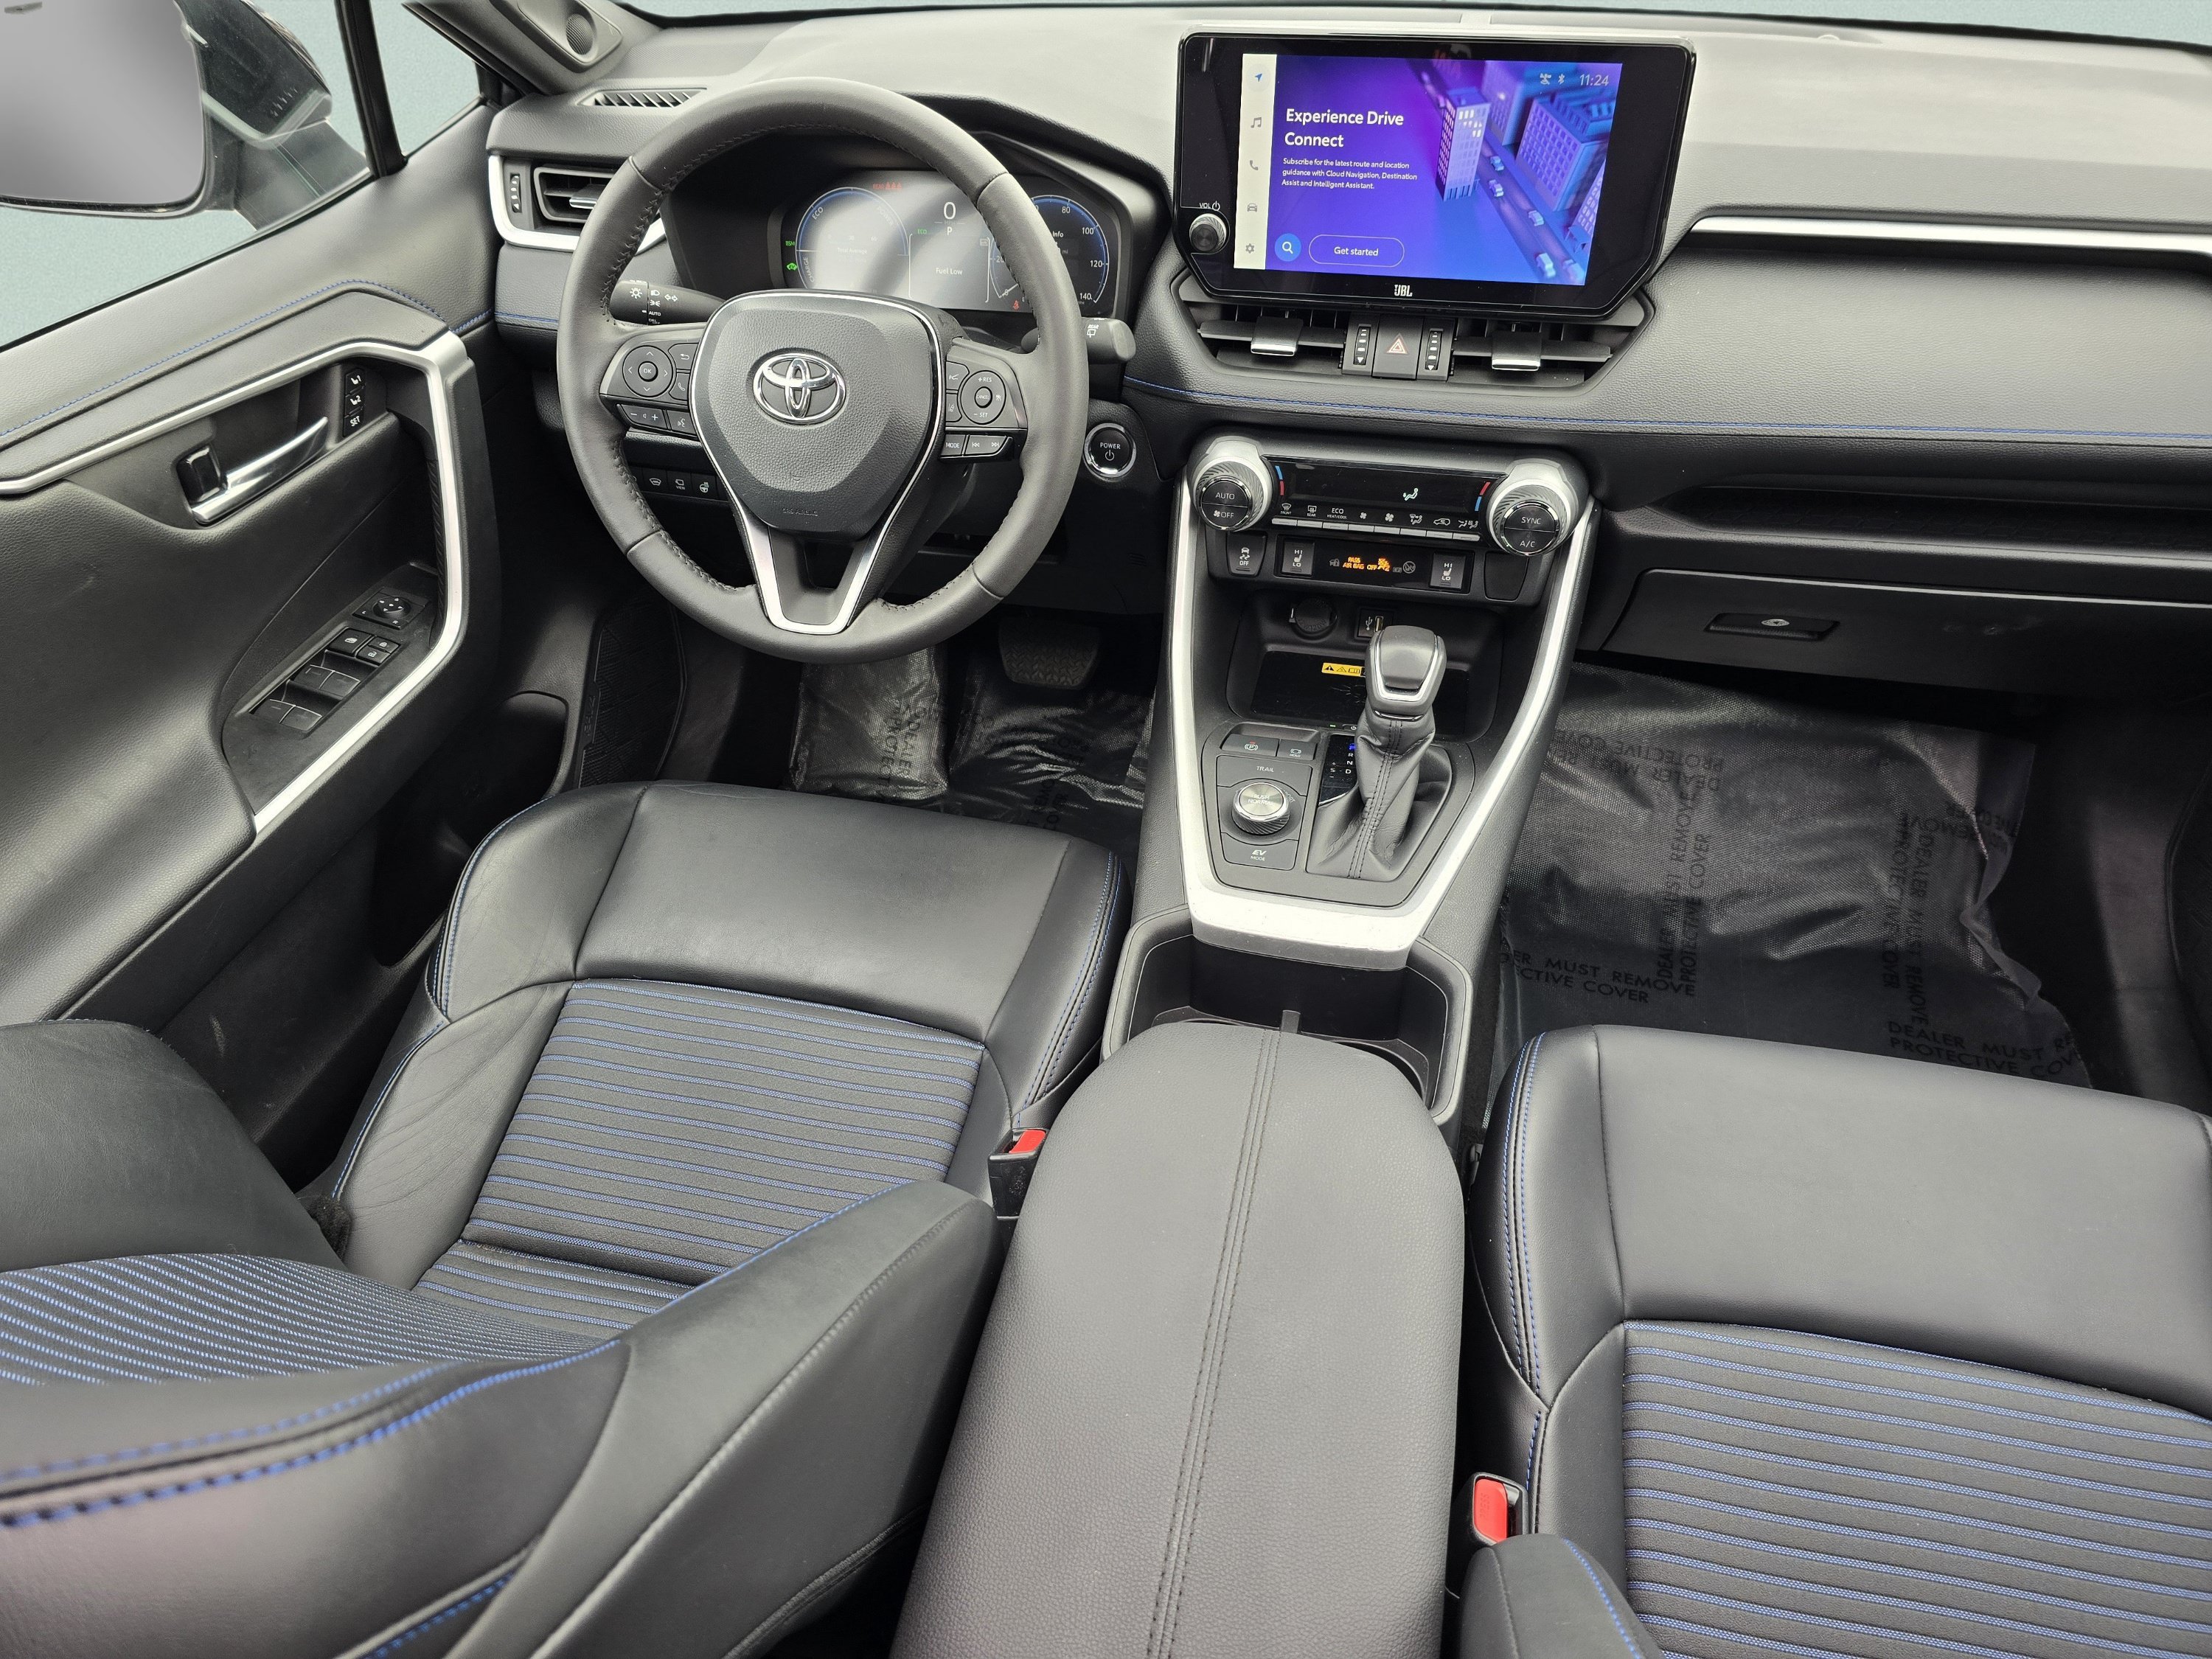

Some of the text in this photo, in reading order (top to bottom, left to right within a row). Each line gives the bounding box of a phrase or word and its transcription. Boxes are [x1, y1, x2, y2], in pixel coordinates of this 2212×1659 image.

[1579, 74, 1610, 86] 11:24
[1286, 108, 1404, 125] Experience Drive
[1284, 132, 1343, 147] Connect
[1324, 159, 1334, 167] the
[1335, 159, 1352, 167] latest
[1371, 160, 1383, 168] and
[1282, 169, 1311, 177] guidance
[1346, 171, 1380, 180] Navigation,
[1381, 173, 1417, 181] Destination
[1313, 181, 1345, 189] Intelligent
[1345, 181, 1375, 189] Assistant.
[812, 206, 824, 220] ECO
[943, 201, 956, 220] 0
[947, 226, 953, 236] P
[1334, 246, 1379, 257] Get started
[950, 268, 963, 276] Low
[1394, 284, 1413, 297] JBL
[350, 415, 360, 427] SET
[1215, 492, 1235, 500] AUTO
[1521, 516, 1542, 525] SYNC
[1689, 833, 1712, 889] COVER
[1545, 958, 1600, 978] MUST
[1613, 970, 1695, 996] REMOVE
[1583, 980, 1649, 1003] COVER
[1888, 1020, 2045, 1061] DEALER MUST
[1890, 1037, 2019, 1075] PROTECTIVE
